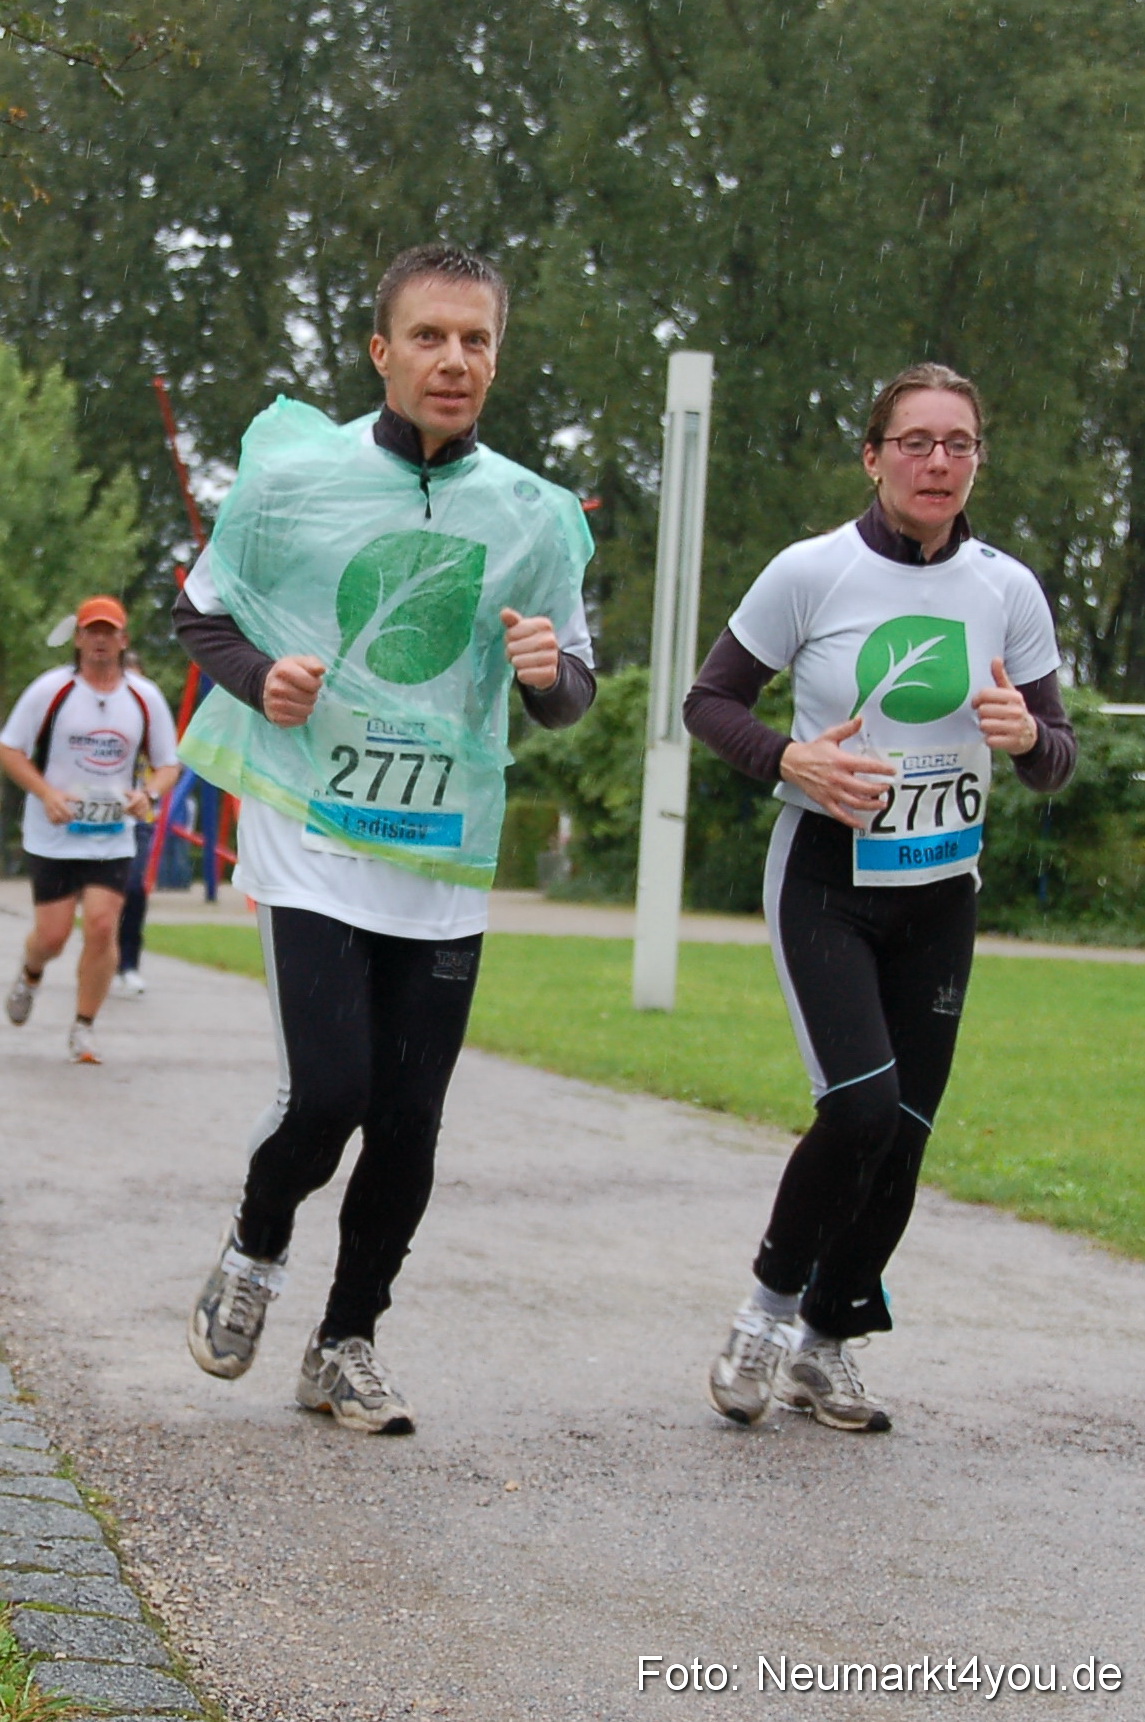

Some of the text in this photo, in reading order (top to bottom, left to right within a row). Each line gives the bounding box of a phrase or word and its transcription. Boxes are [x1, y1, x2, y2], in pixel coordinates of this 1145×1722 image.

[325, 744, 454, 807] 2777
[870, 771, 982, 834] 2776
[898, 839, 959, 866] Renate
